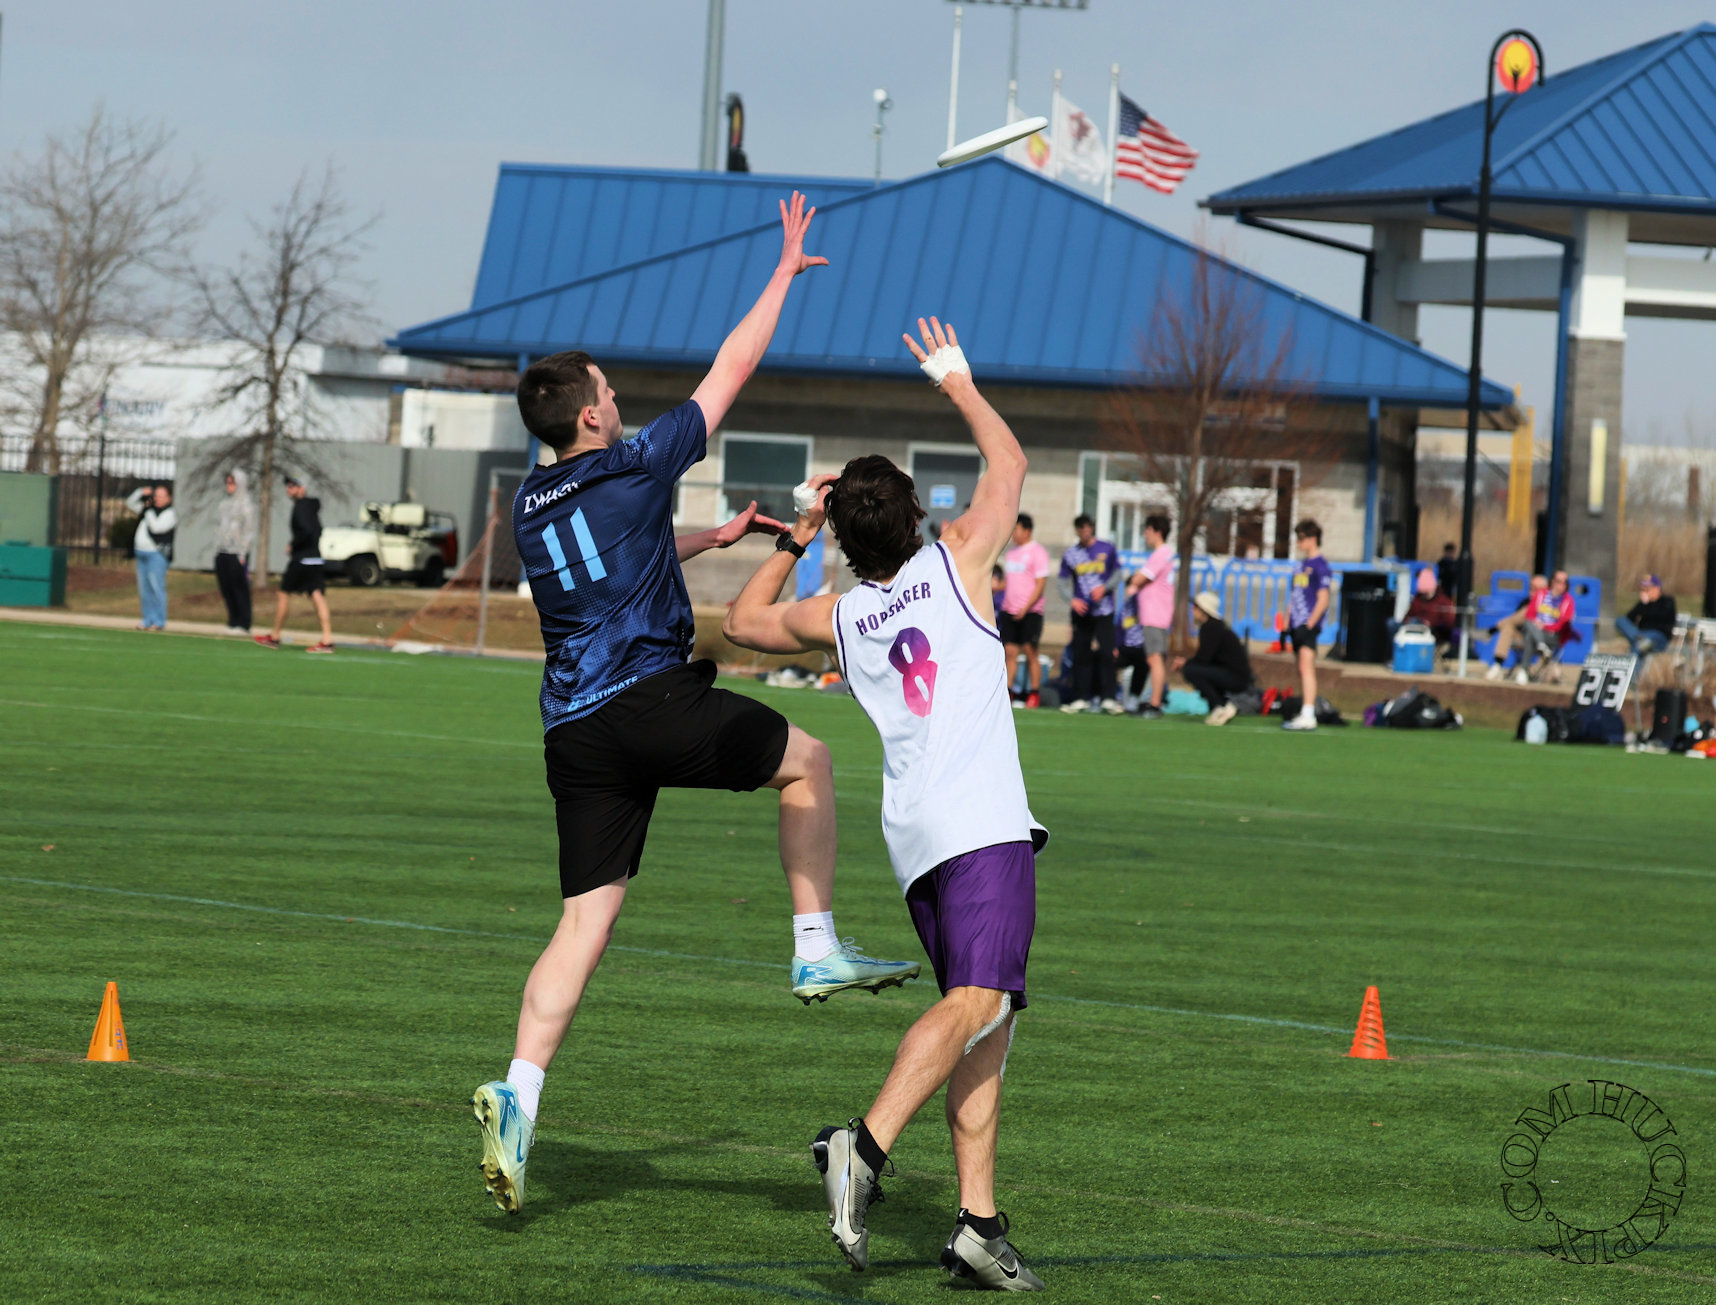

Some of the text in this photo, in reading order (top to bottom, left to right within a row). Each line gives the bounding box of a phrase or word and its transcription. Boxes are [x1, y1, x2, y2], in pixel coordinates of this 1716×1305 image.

[541, 506, 607, 591] 11
[586, 675, 638, 704] ULTIMATE
[888, 626, 938, 718] 8
